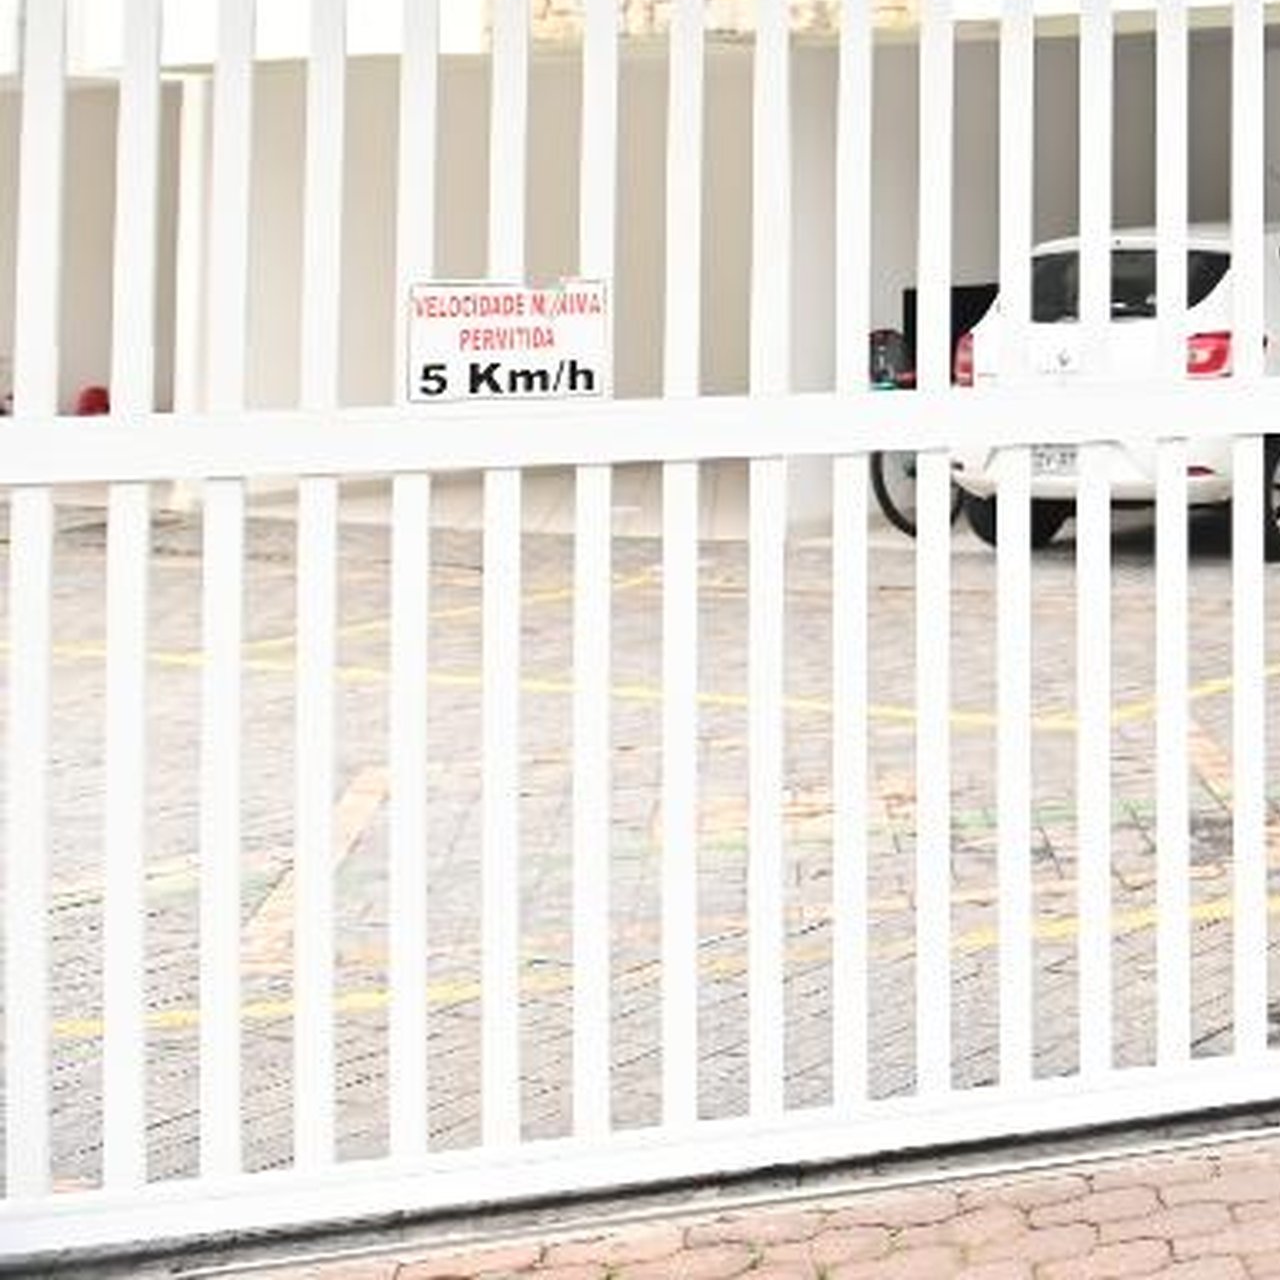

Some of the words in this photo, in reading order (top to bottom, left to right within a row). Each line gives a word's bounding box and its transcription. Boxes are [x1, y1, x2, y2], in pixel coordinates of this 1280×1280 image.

[414, 293, 526, 318] VELOCIDADE
[459, 326, 556, 351] PERMITIDA
[419, 362, 449, 396] 5
[468, 359, 596, 394] Km/h
